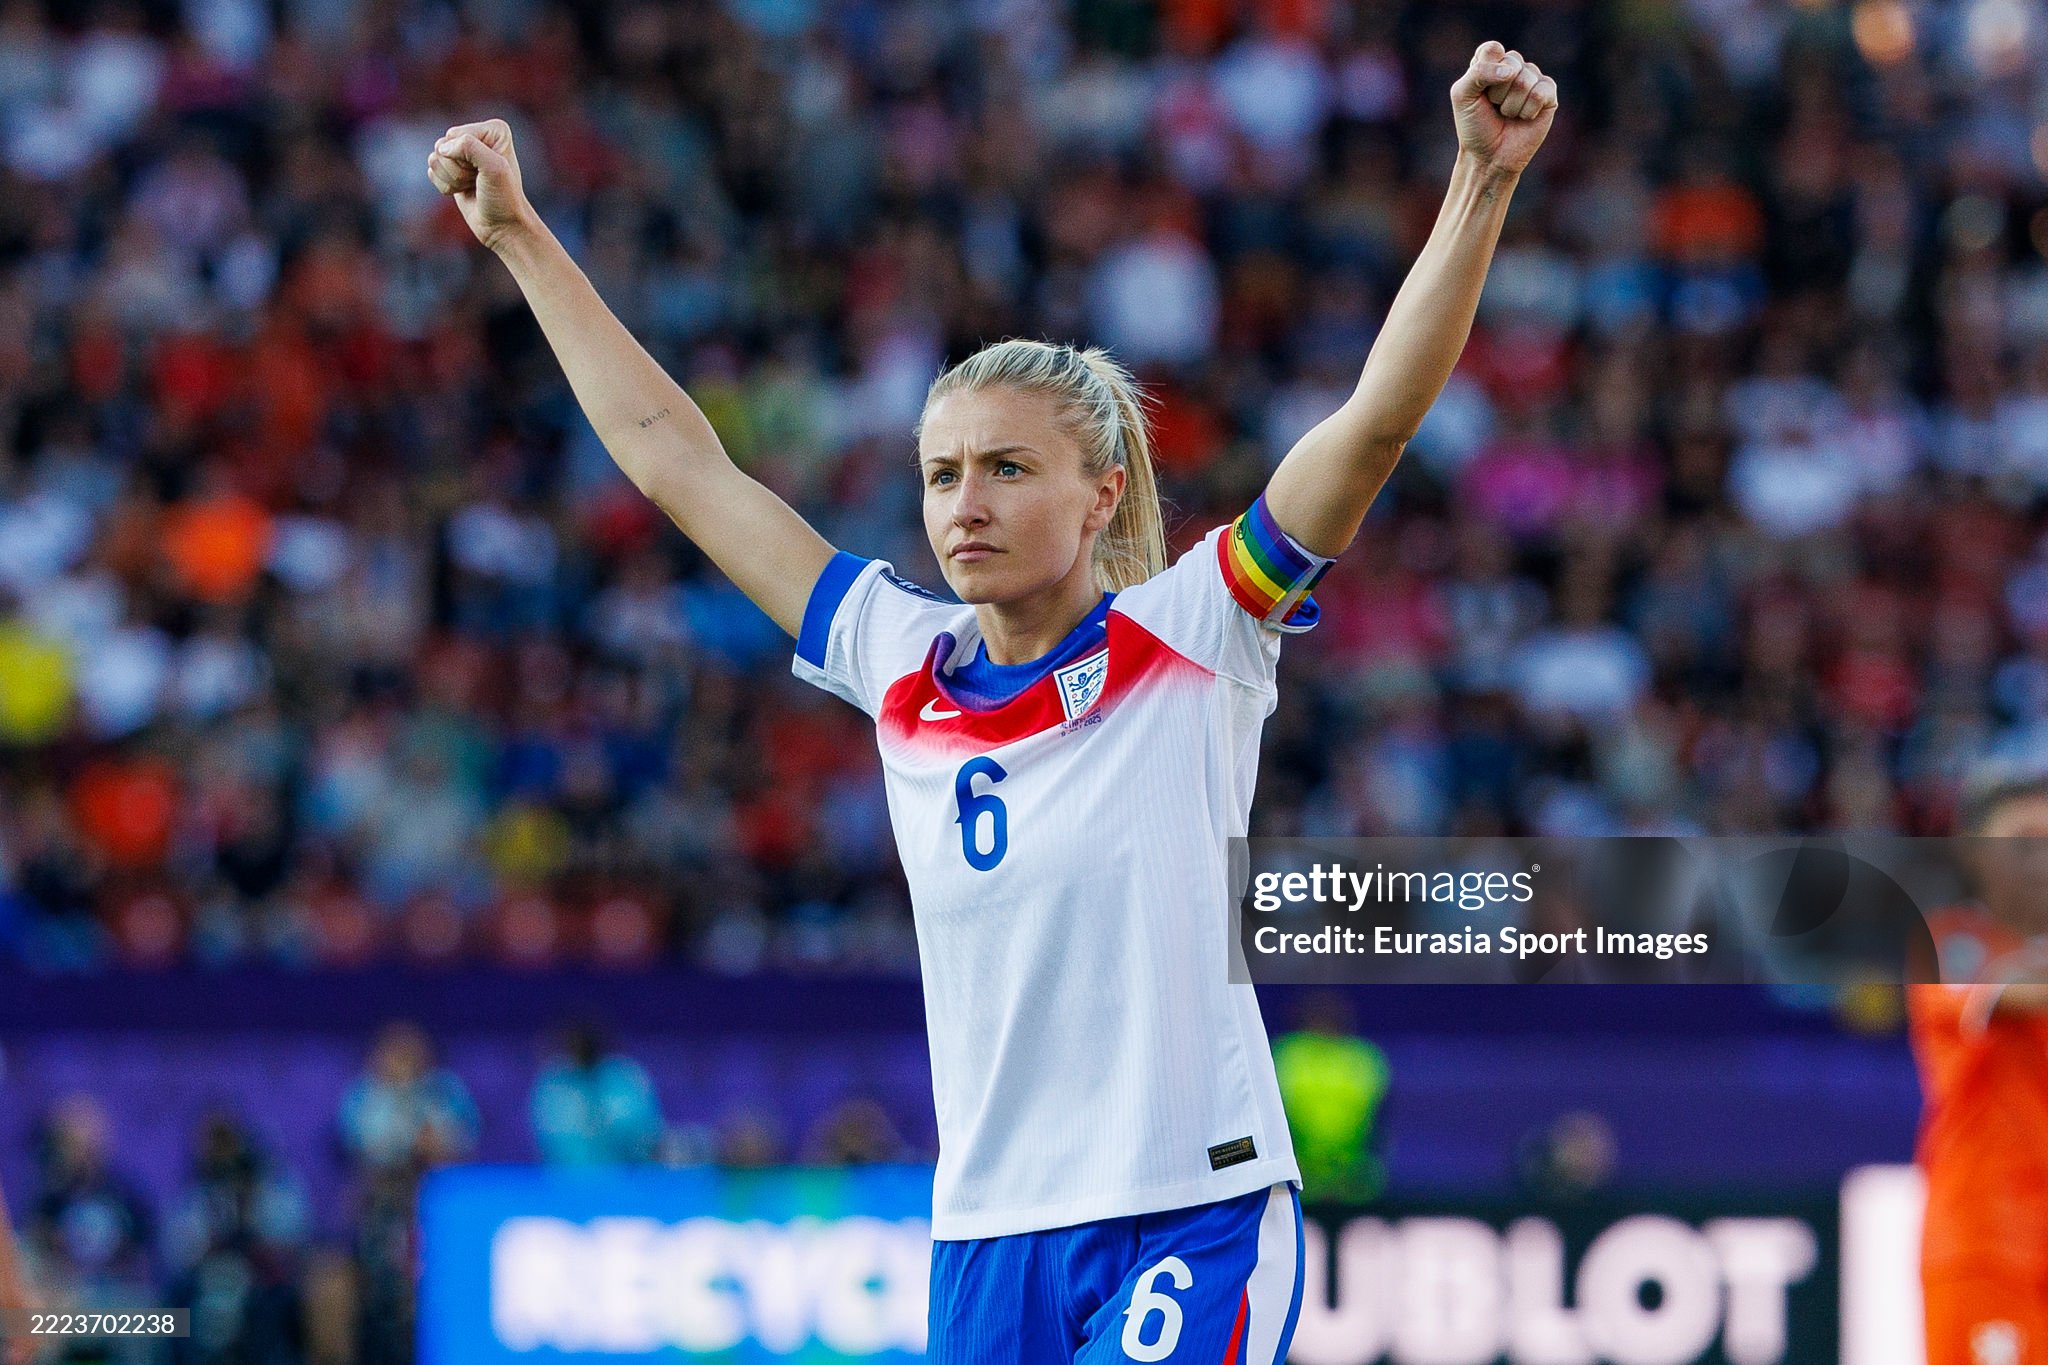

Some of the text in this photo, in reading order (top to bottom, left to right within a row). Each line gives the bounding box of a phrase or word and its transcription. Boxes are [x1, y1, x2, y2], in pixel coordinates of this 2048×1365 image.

[638, 408, 671, 428] LOVER
[1084, 713, 1102, 727] 2025
[955, 756, 1008, 872] 6
[1121, 1256, 1194, 1364] 6
